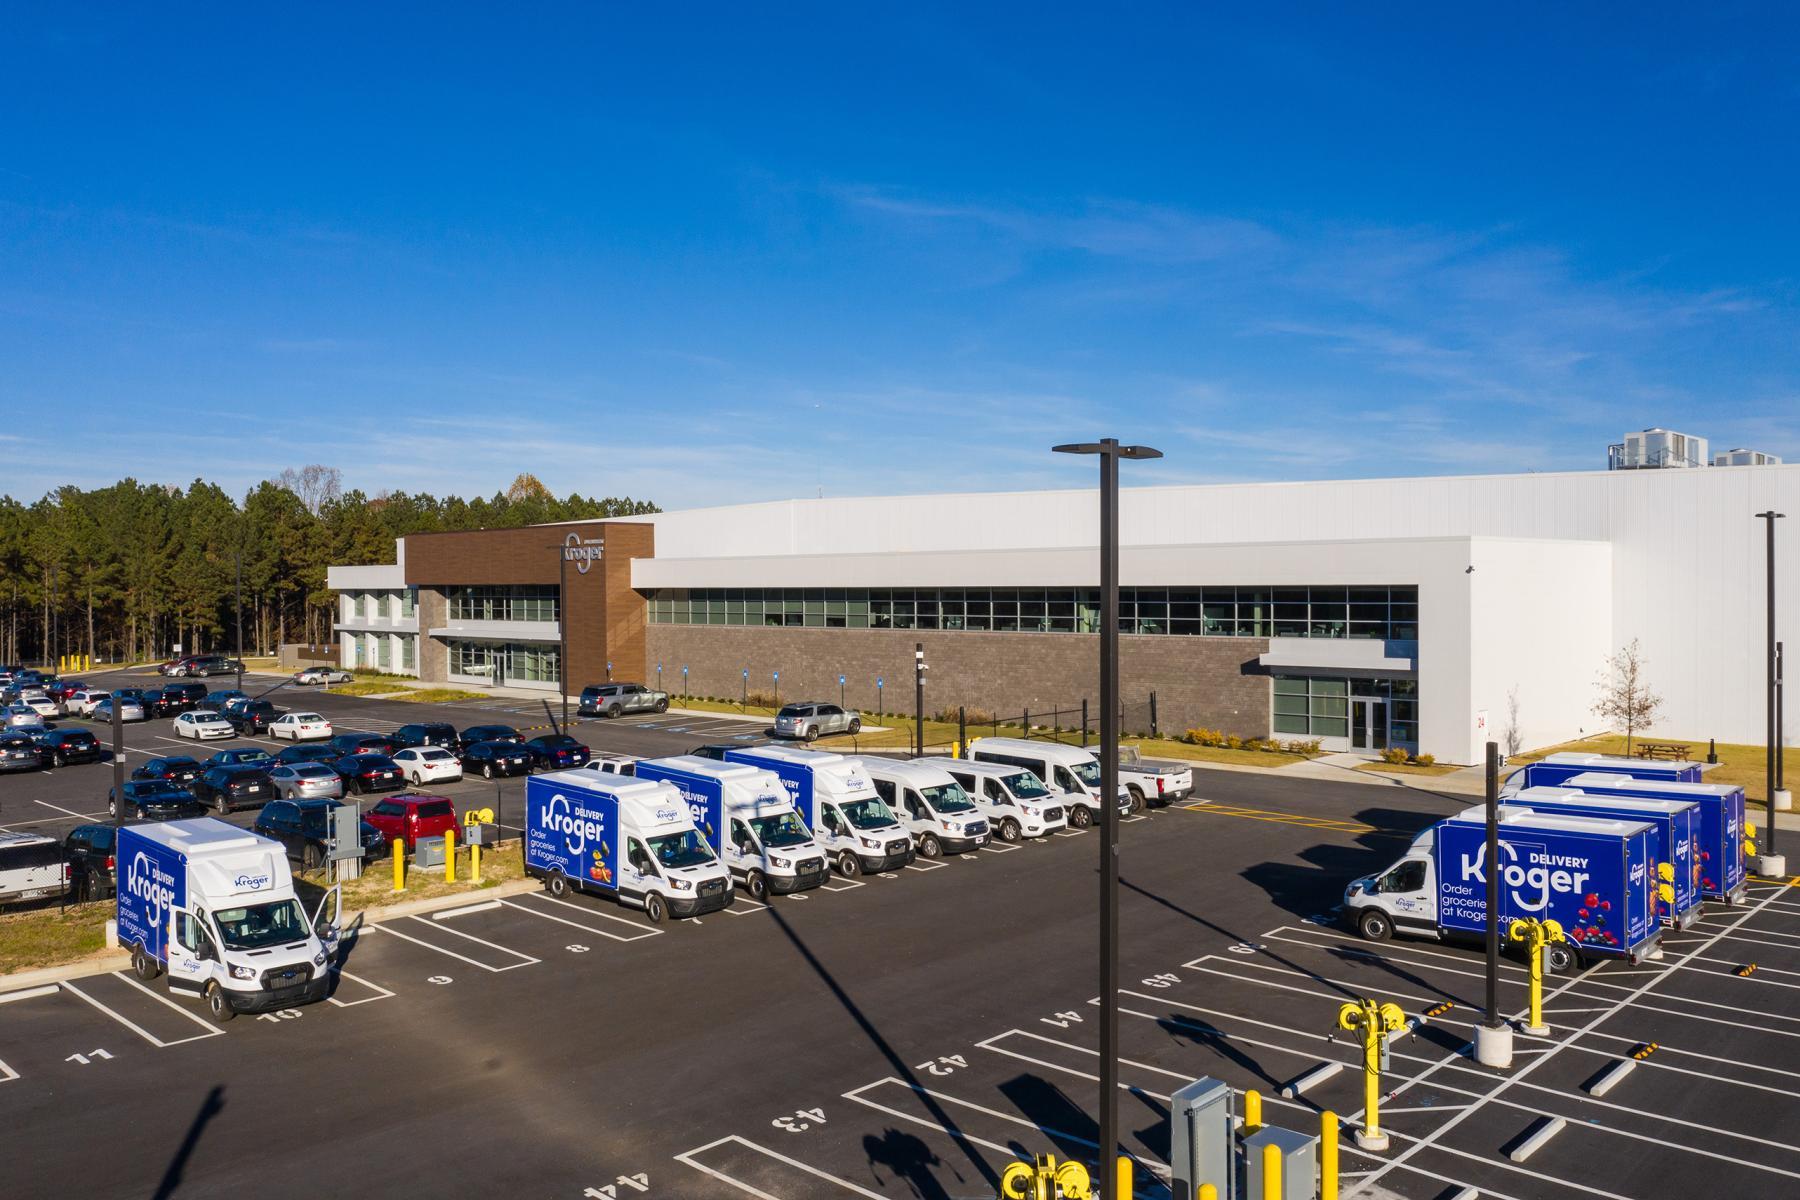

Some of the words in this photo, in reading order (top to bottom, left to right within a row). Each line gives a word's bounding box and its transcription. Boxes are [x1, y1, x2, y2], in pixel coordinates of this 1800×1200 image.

[574, 807, 604, 821] DELIVERY
[541, 794, 605, 855] Kroger
[530, 828, 547, 840] Order
[530, 839, 556, 852] groceries
[530, 848, 537, 856] at
[537, 849, 569, 865] Kroger.com
[1529, 852, 1589, 869] DELIVERY
[152, 868, 175, 887] DELIVERY
[234, 874, 269, 890] Kroger
[1461, 839, 1590, 912] Koger
[128, 851, 175, 928] Kroger
[1442, 882, 1473, 896] Order
[1396, 897, 1416, 910] Kroger
[1442, 896, 1487, 909] grocerie
[1442, 907, 1454, 916] at
[565, 944, 591, 953] 8
[427, 975, 454, 985] 9
[256, 1008, 303, 1023] 10
[1039, 1010, 1084, 1028] 41
[64, 1048, 115, 1065] 11
[914, 1054, 969, 1076] 42
[771, 1107, 827, 1133] 43
[583, 1172, 650, 1200] 44
